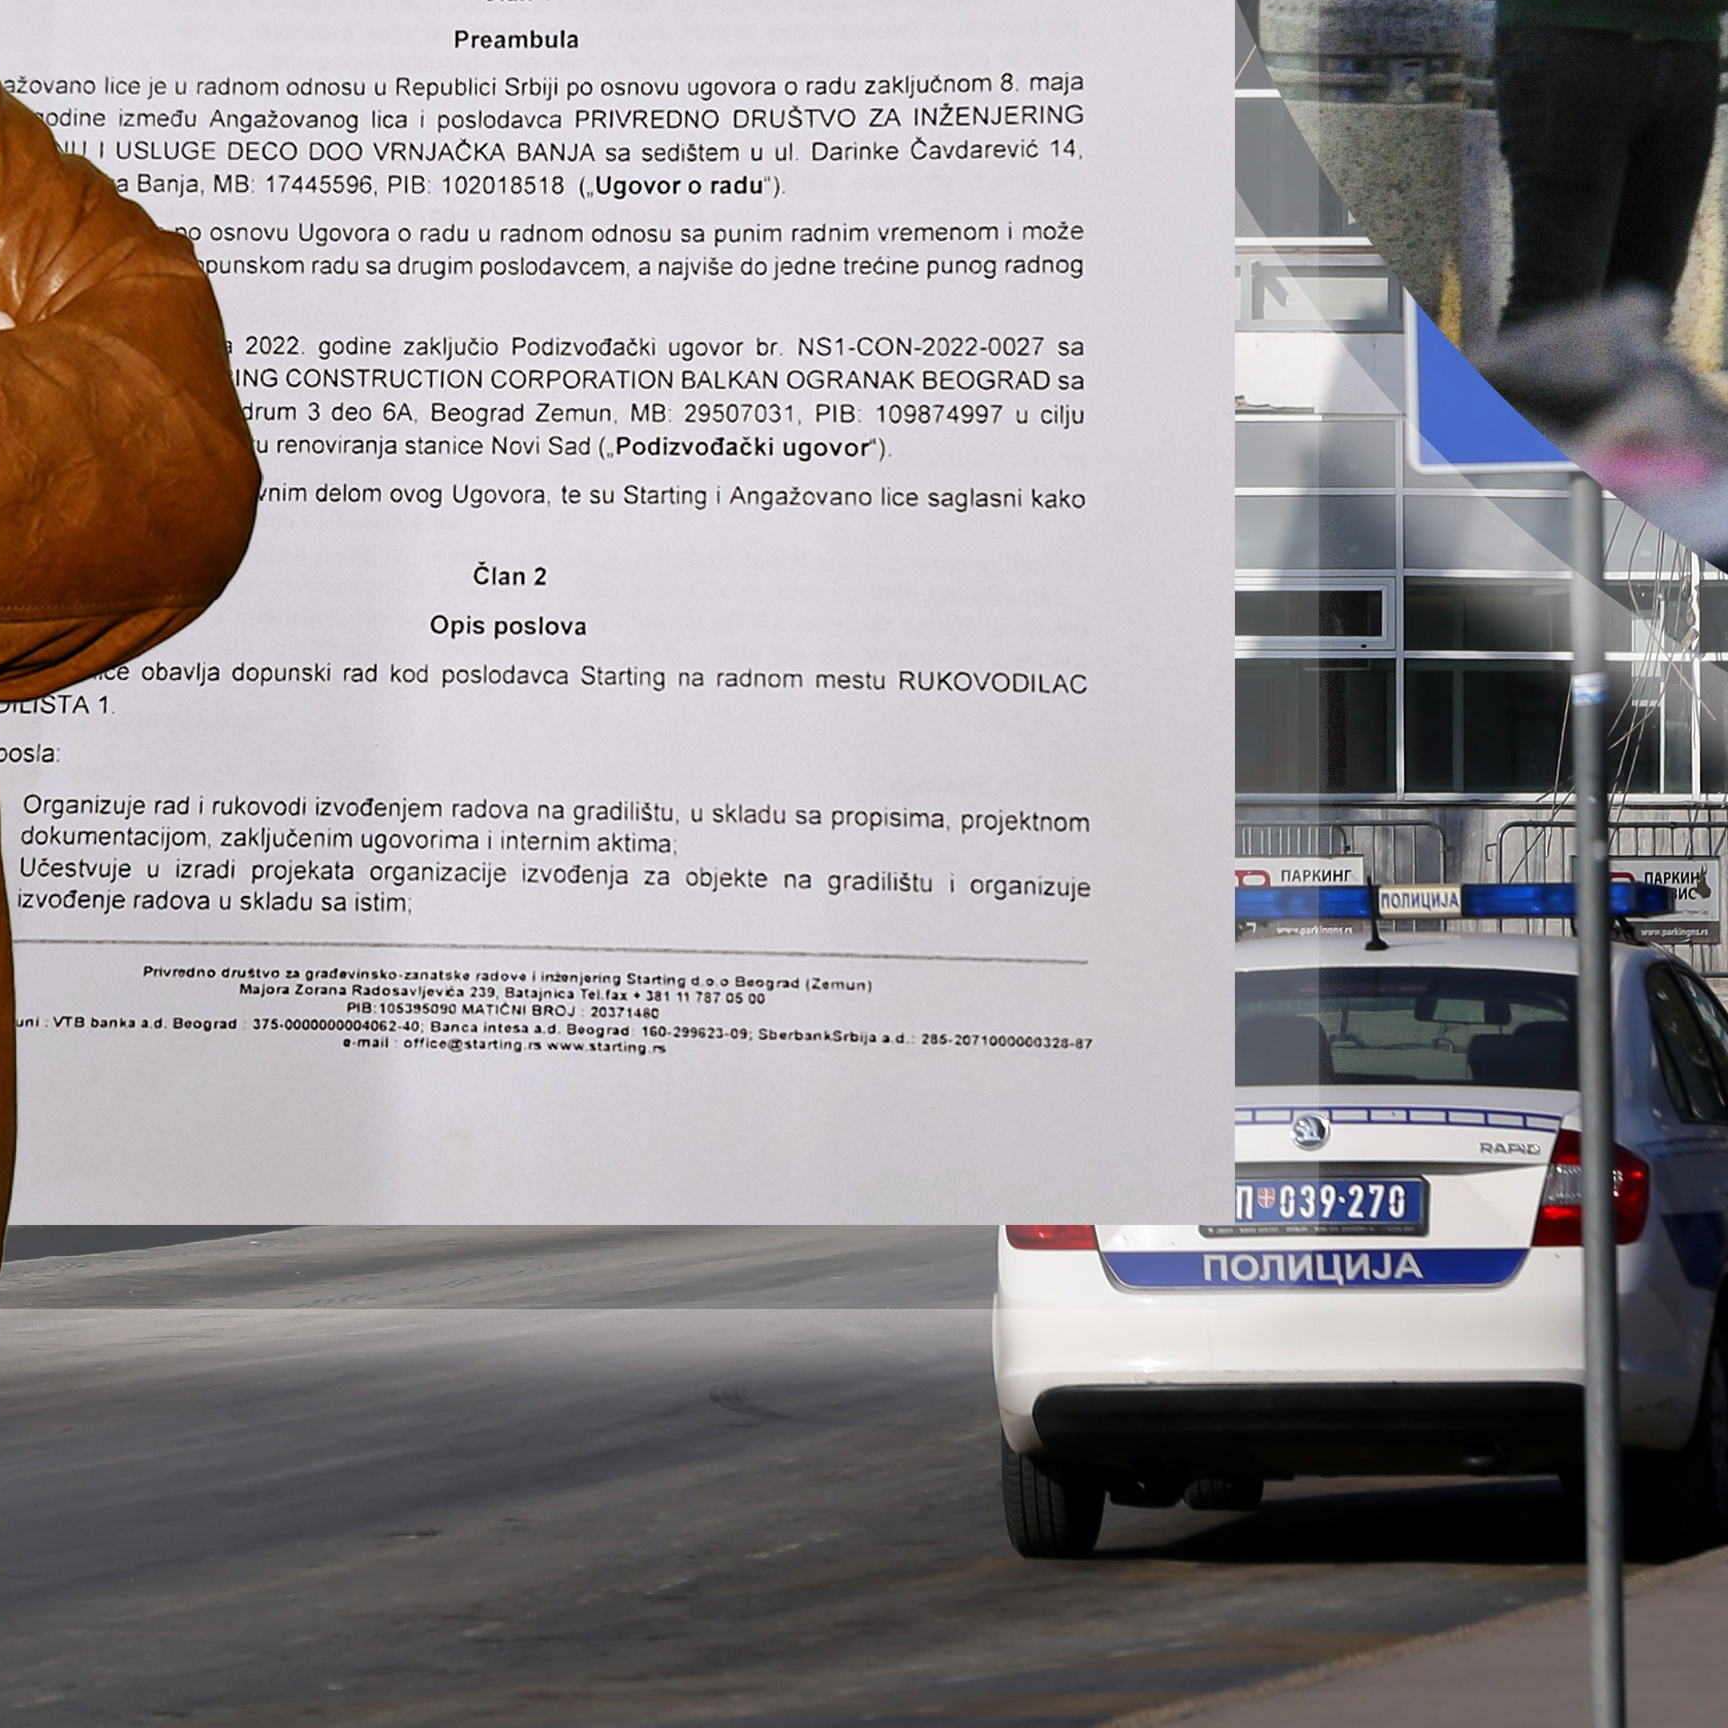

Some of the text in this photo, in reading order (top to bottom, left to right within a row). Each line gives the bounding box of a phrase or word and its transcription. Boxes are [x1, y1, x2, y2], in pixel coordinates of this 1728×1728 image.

[454, 29, 579, 50] Preambula
[3, 71, 1084, 102] ažovano lice je u radnom odnosu u Republici Srbiji po osnovu ugovora o radu zaključnom 8. maja
[136, 174, 207, 198] Banja,
[213, 173, 257, 195] MB:
[265, 173, 380, 199] 17445596,
[387, 174, 433, 196] PIB:
[440, 174, 567, 197] 102018518
[578, 174, 683, 201] („Ugovor
[687, 178, 703, 196] o
[472, 560, 547, 587] Član 2
[429, 614, 587, 641] Opis poslova
[1280, 868, 1353, 883] ПАРКИНГ
[1644, 871, 1700, 885] ПАРКИН
[1380, 890, 1460, 912] ПОЛИЦИЈА
[238, 983, 767, 1007] Majora Zorana Radosavljevića 239, Batajnica Tel.fax + 381 11 787 05 00
[1479, 1140, 1542, 1156] RAPID
[1202, 1252, 1424, 1286] ПОЛИЦИЈА
